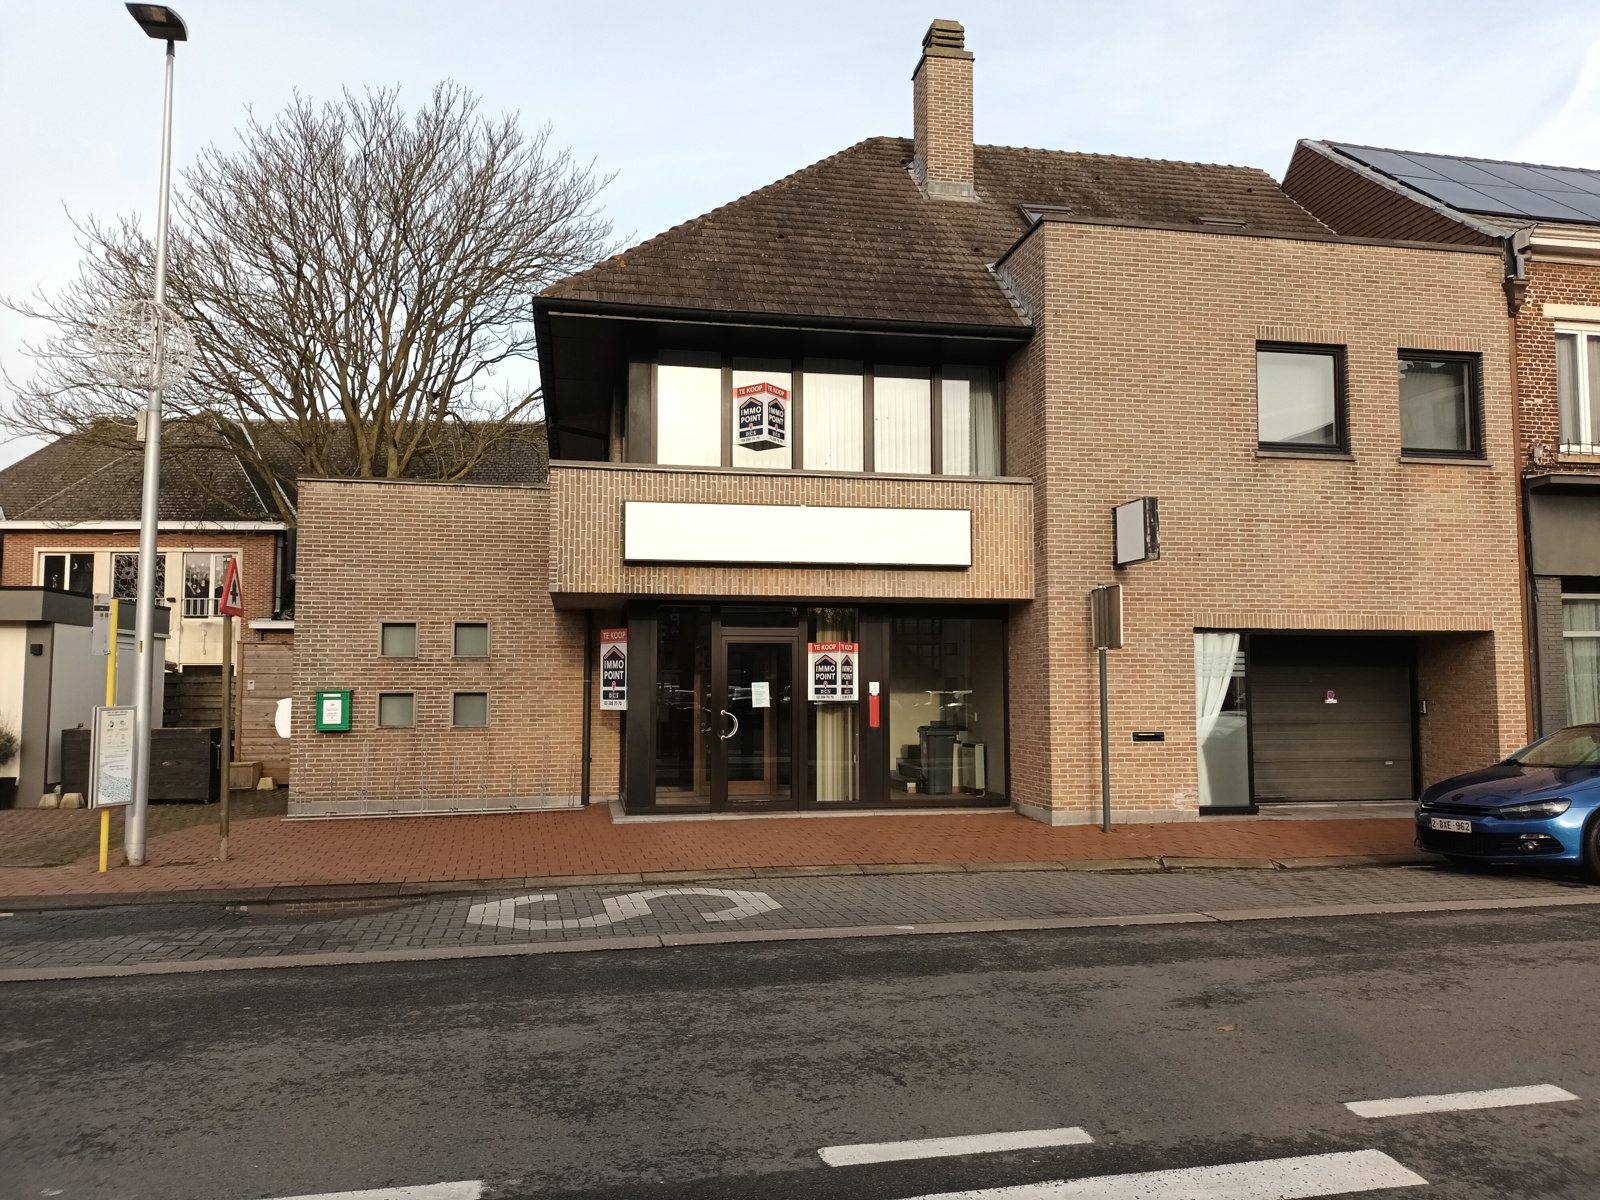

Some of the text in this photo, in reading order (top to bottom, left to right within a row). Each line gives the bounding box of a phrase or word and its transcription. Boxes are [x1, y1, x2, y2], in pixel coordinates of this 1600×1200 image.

[746, 384, 763, 394] KOOP
[773, 387, 784, 396] KOOP
[740, 406, 762, 416] IMMO
[768, 406, 784, 418] IMMO
[740, 414, 762, 424] POINT
[768, 414, 784, 426] POINT
[604, 660, 624, 669] IMMO
[604, 670, 624, 680] POINT
[1432, 819, 1470, 831] 2-BXE-962
